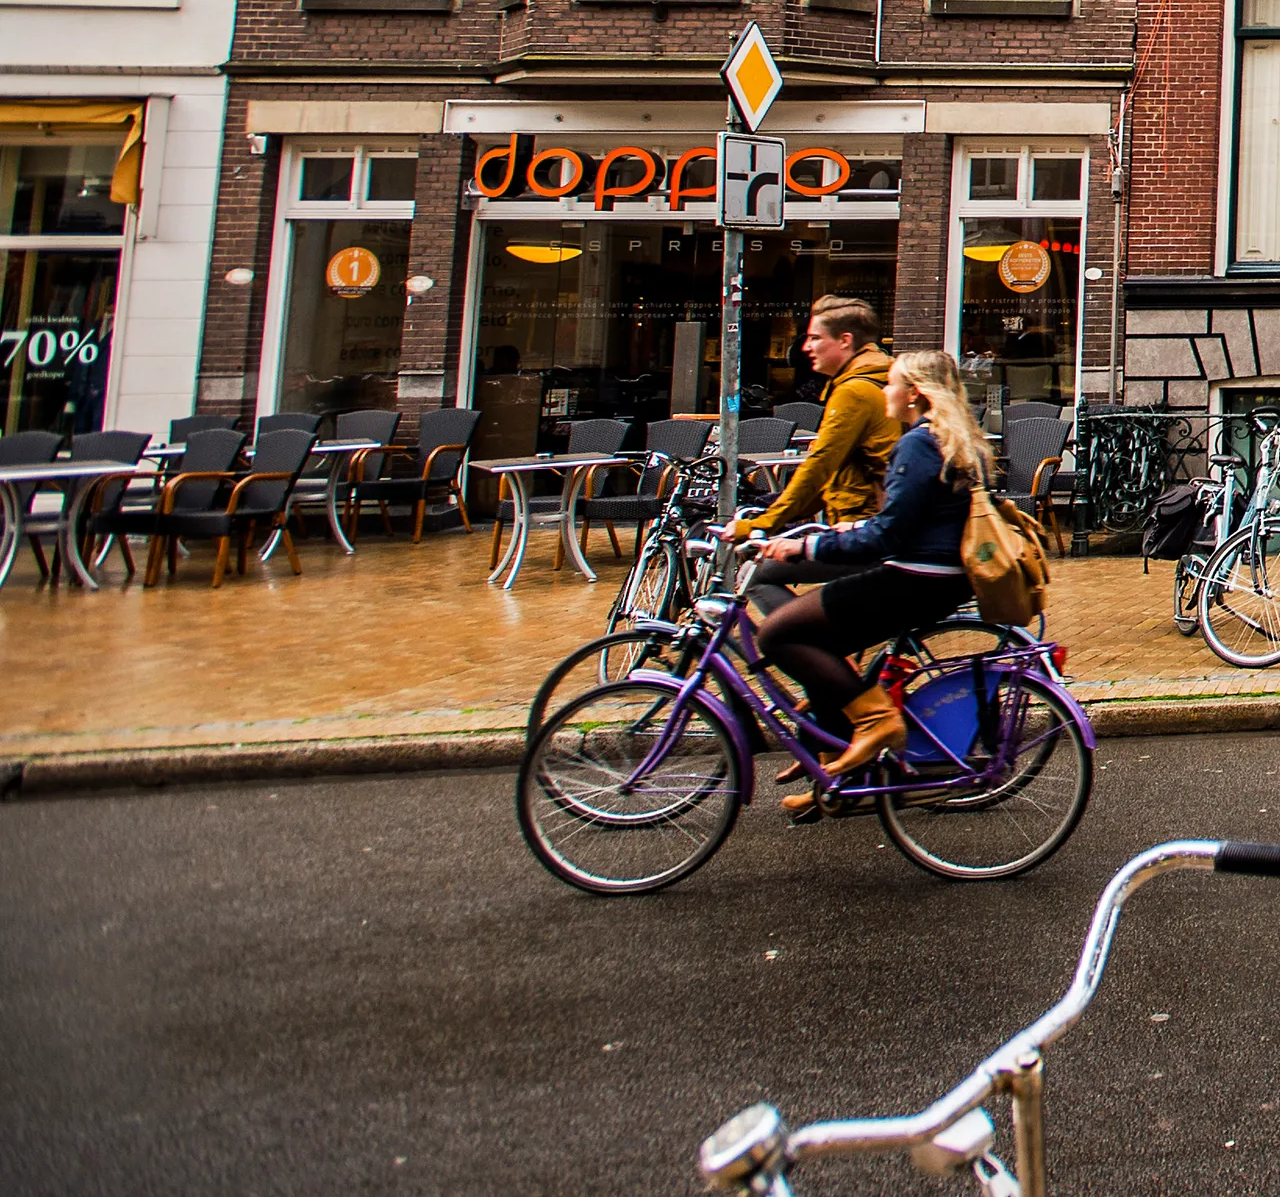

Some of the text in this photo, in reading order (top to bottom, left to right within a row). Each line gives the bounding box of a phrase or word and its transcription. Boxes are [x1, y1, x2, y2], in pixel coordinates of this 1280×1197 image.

[474, 133, 851, 211] doppo
[549, 239, 844, 252] ESPRESSO
[349, 261, 360, 281] 1
[0, 328, 99, 368] 70%
